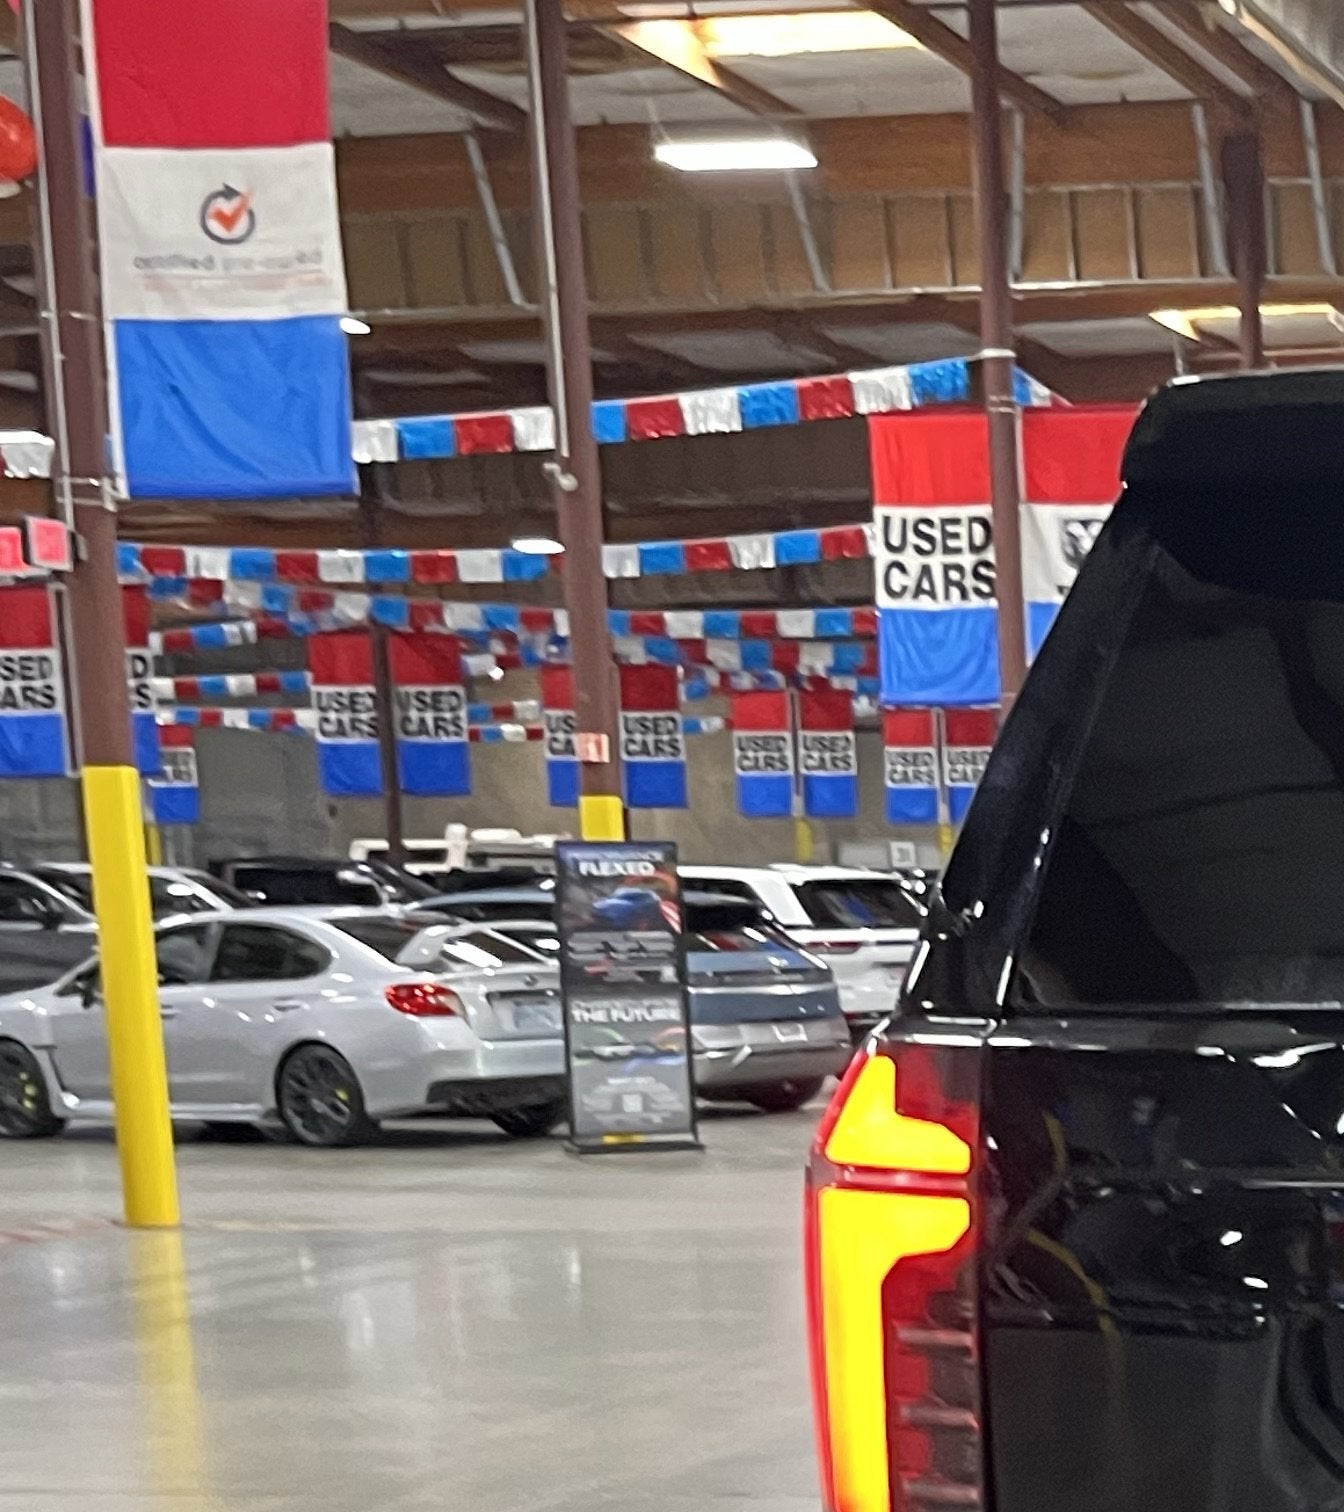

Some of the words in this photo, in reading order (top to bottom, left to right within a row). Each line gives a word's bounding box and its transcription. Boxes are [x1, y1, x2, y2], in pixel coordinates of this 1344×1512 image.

[882, 515, 992, 556] USED
[884, 559, 996, 601] CARS
[401, 715, 464, 737] CARS
[623, 716, 679, 735] USED
[625, 737, 682, 757] CARS
